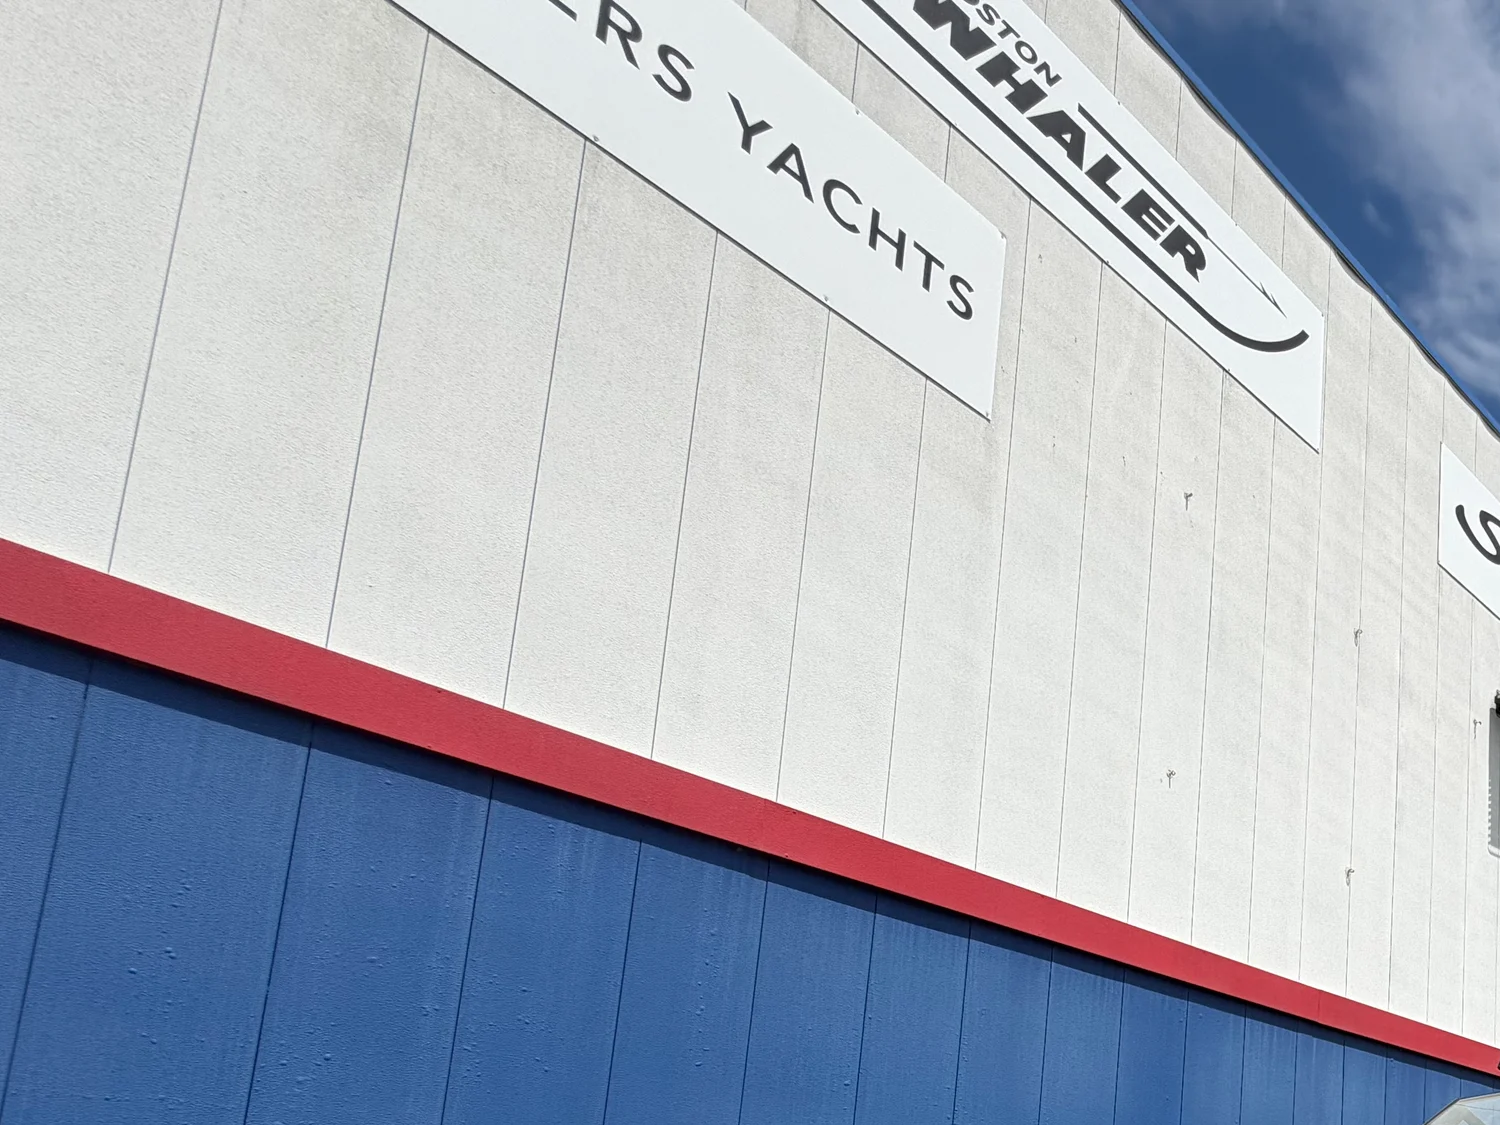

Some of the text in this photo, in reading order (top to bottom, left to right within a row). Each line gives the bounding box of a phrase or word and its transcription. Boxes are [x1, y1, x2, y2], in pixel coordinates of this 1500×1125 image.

[963, 0, 1062, 87] STON
[548, 0, 974, 321] RS YACHTS
